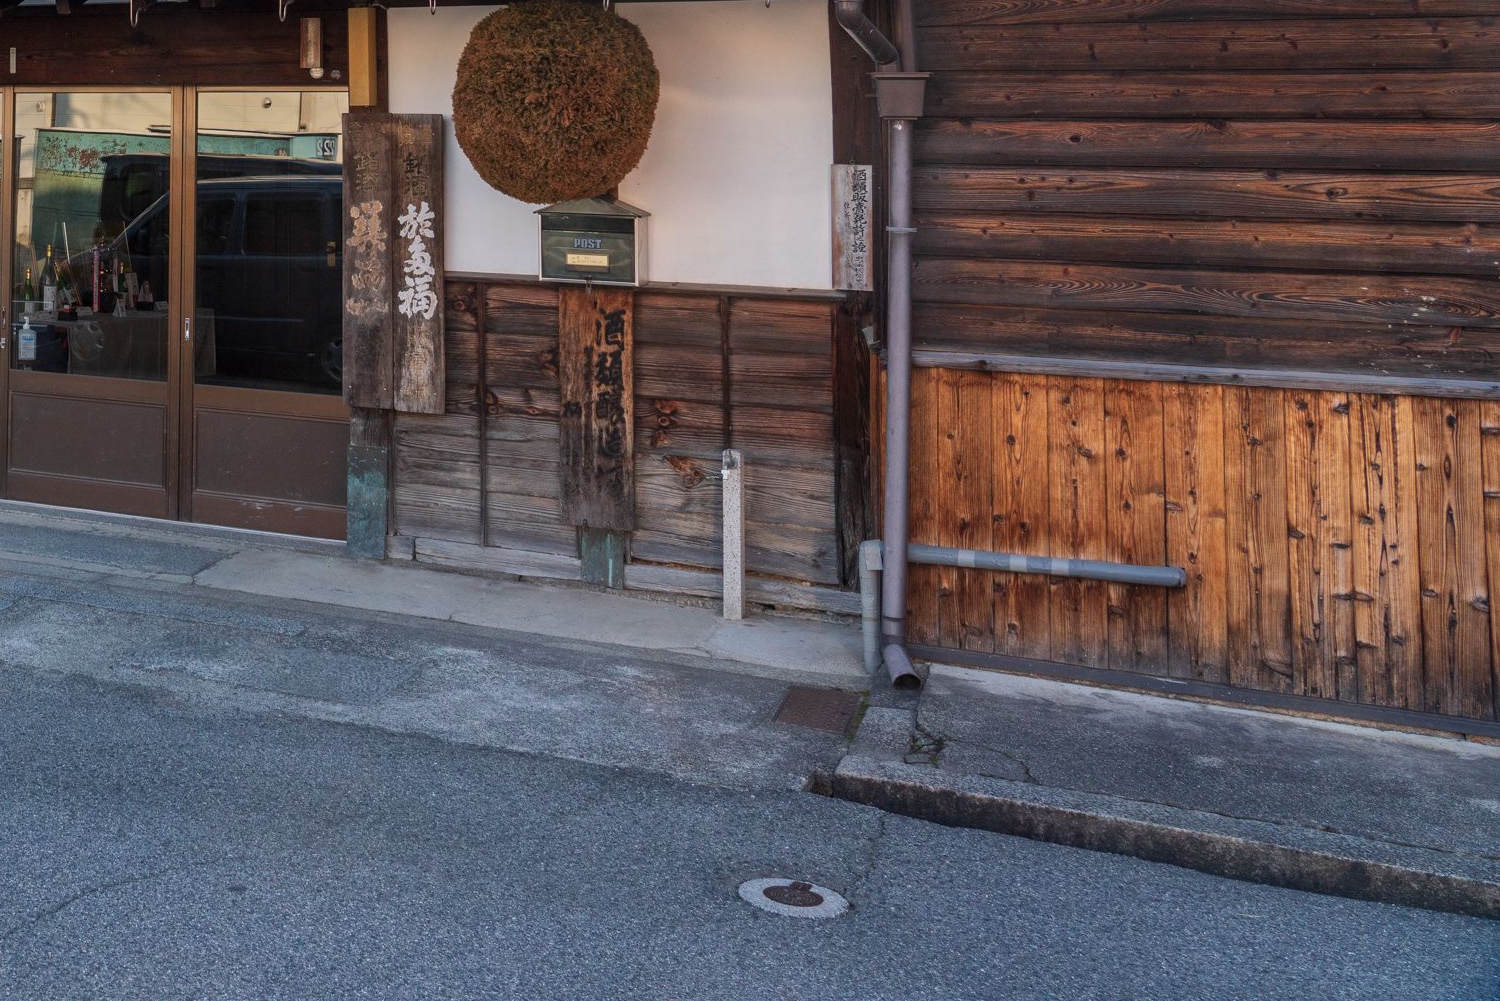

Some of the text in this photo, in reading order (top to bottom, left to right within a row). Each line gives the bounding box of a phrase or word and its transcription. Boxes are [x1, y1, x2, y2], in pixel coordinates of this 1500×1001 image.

[398, 201, 438, 320] 於多福
[573, 237, 602, 249] POST
